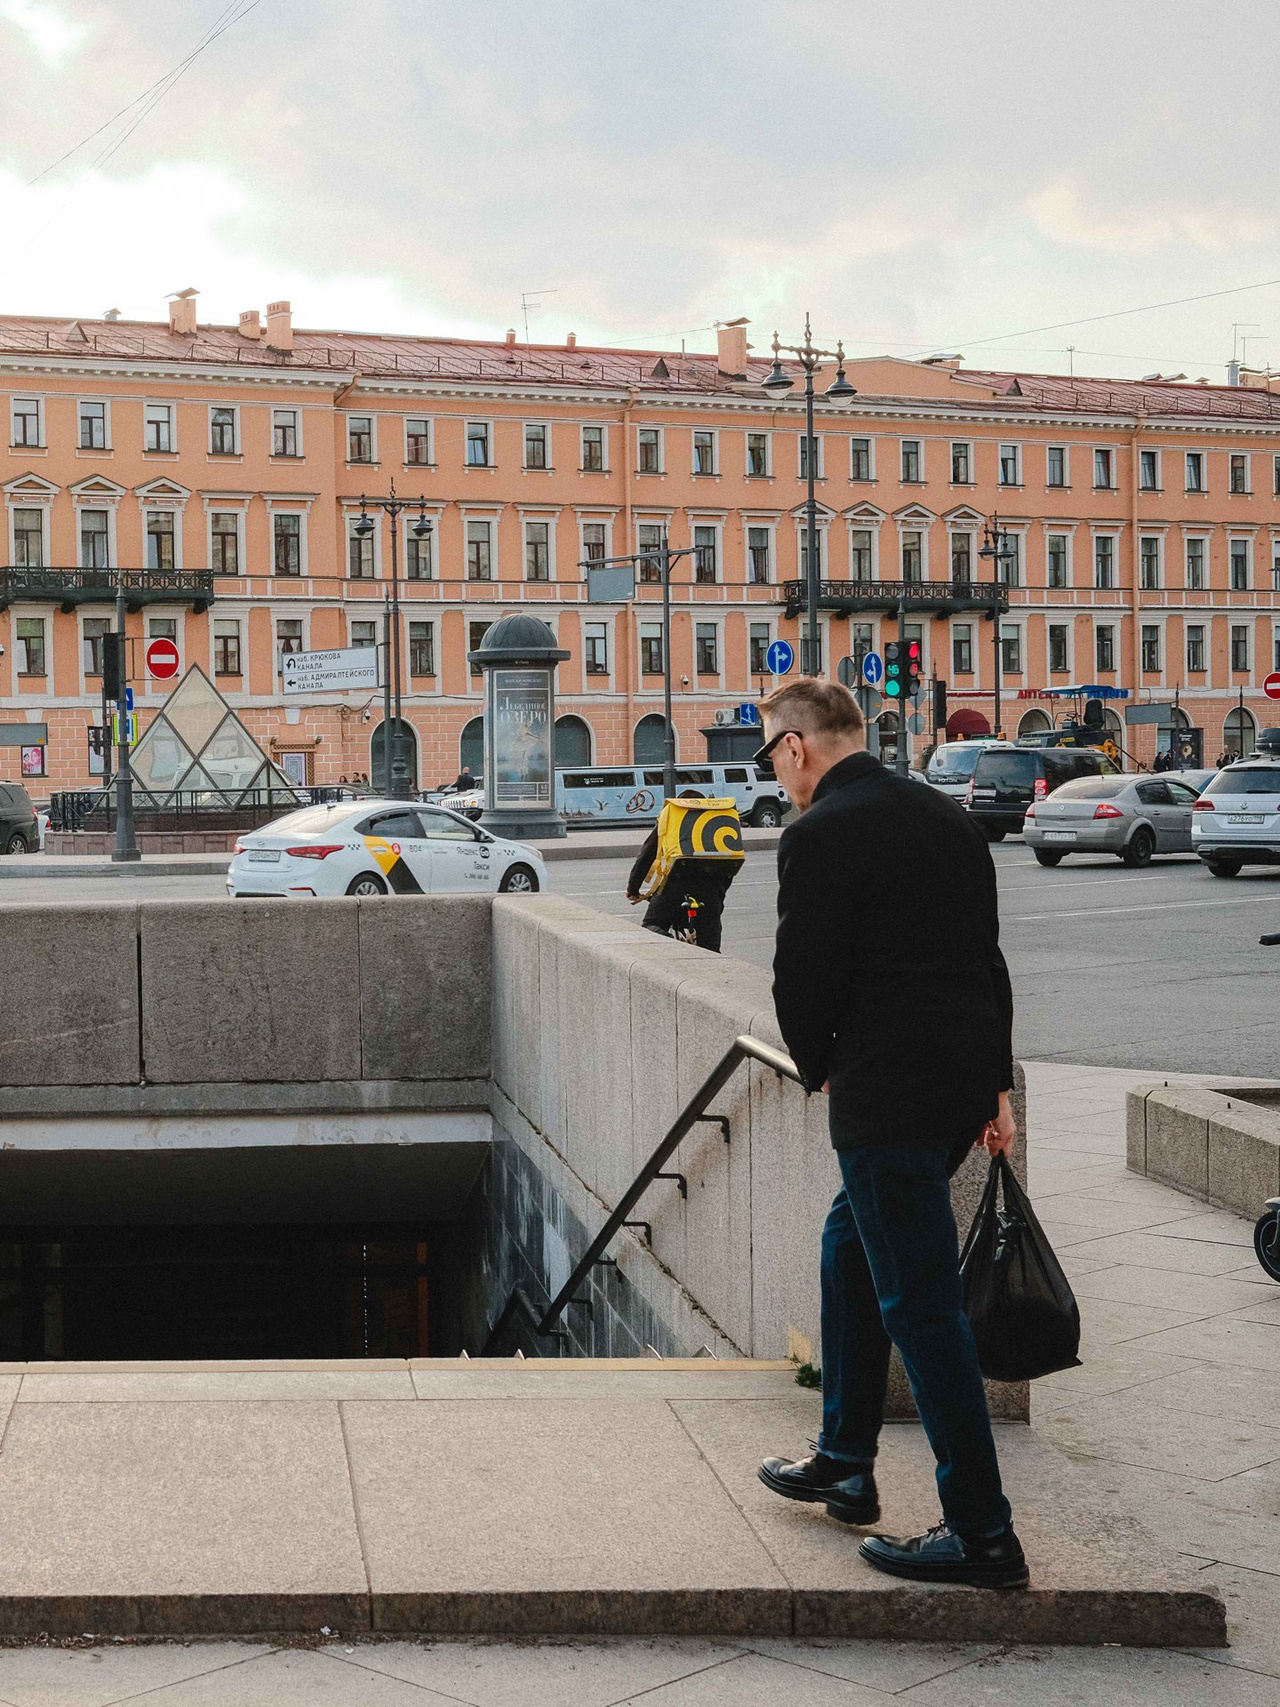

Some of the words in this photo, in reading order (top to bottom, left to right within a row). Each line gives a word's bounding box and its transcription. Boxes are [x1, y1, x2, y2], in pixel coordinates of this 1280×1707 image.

[310, 653, 341, 661] КРЮКОВА
[297, 662, 322, 670] КАНАЛА
[888, 664, 899, 675] 46
[311, 669, 375, 681] АДМИРАЛТЕЙСКОГО
[298, 682, 323, 690] КАНАЛА
[500, 710, 547, 724] ОЗЕРО
[456, 846, 478, 855] Яндекс
[473, 861, 489, 870] Такси
